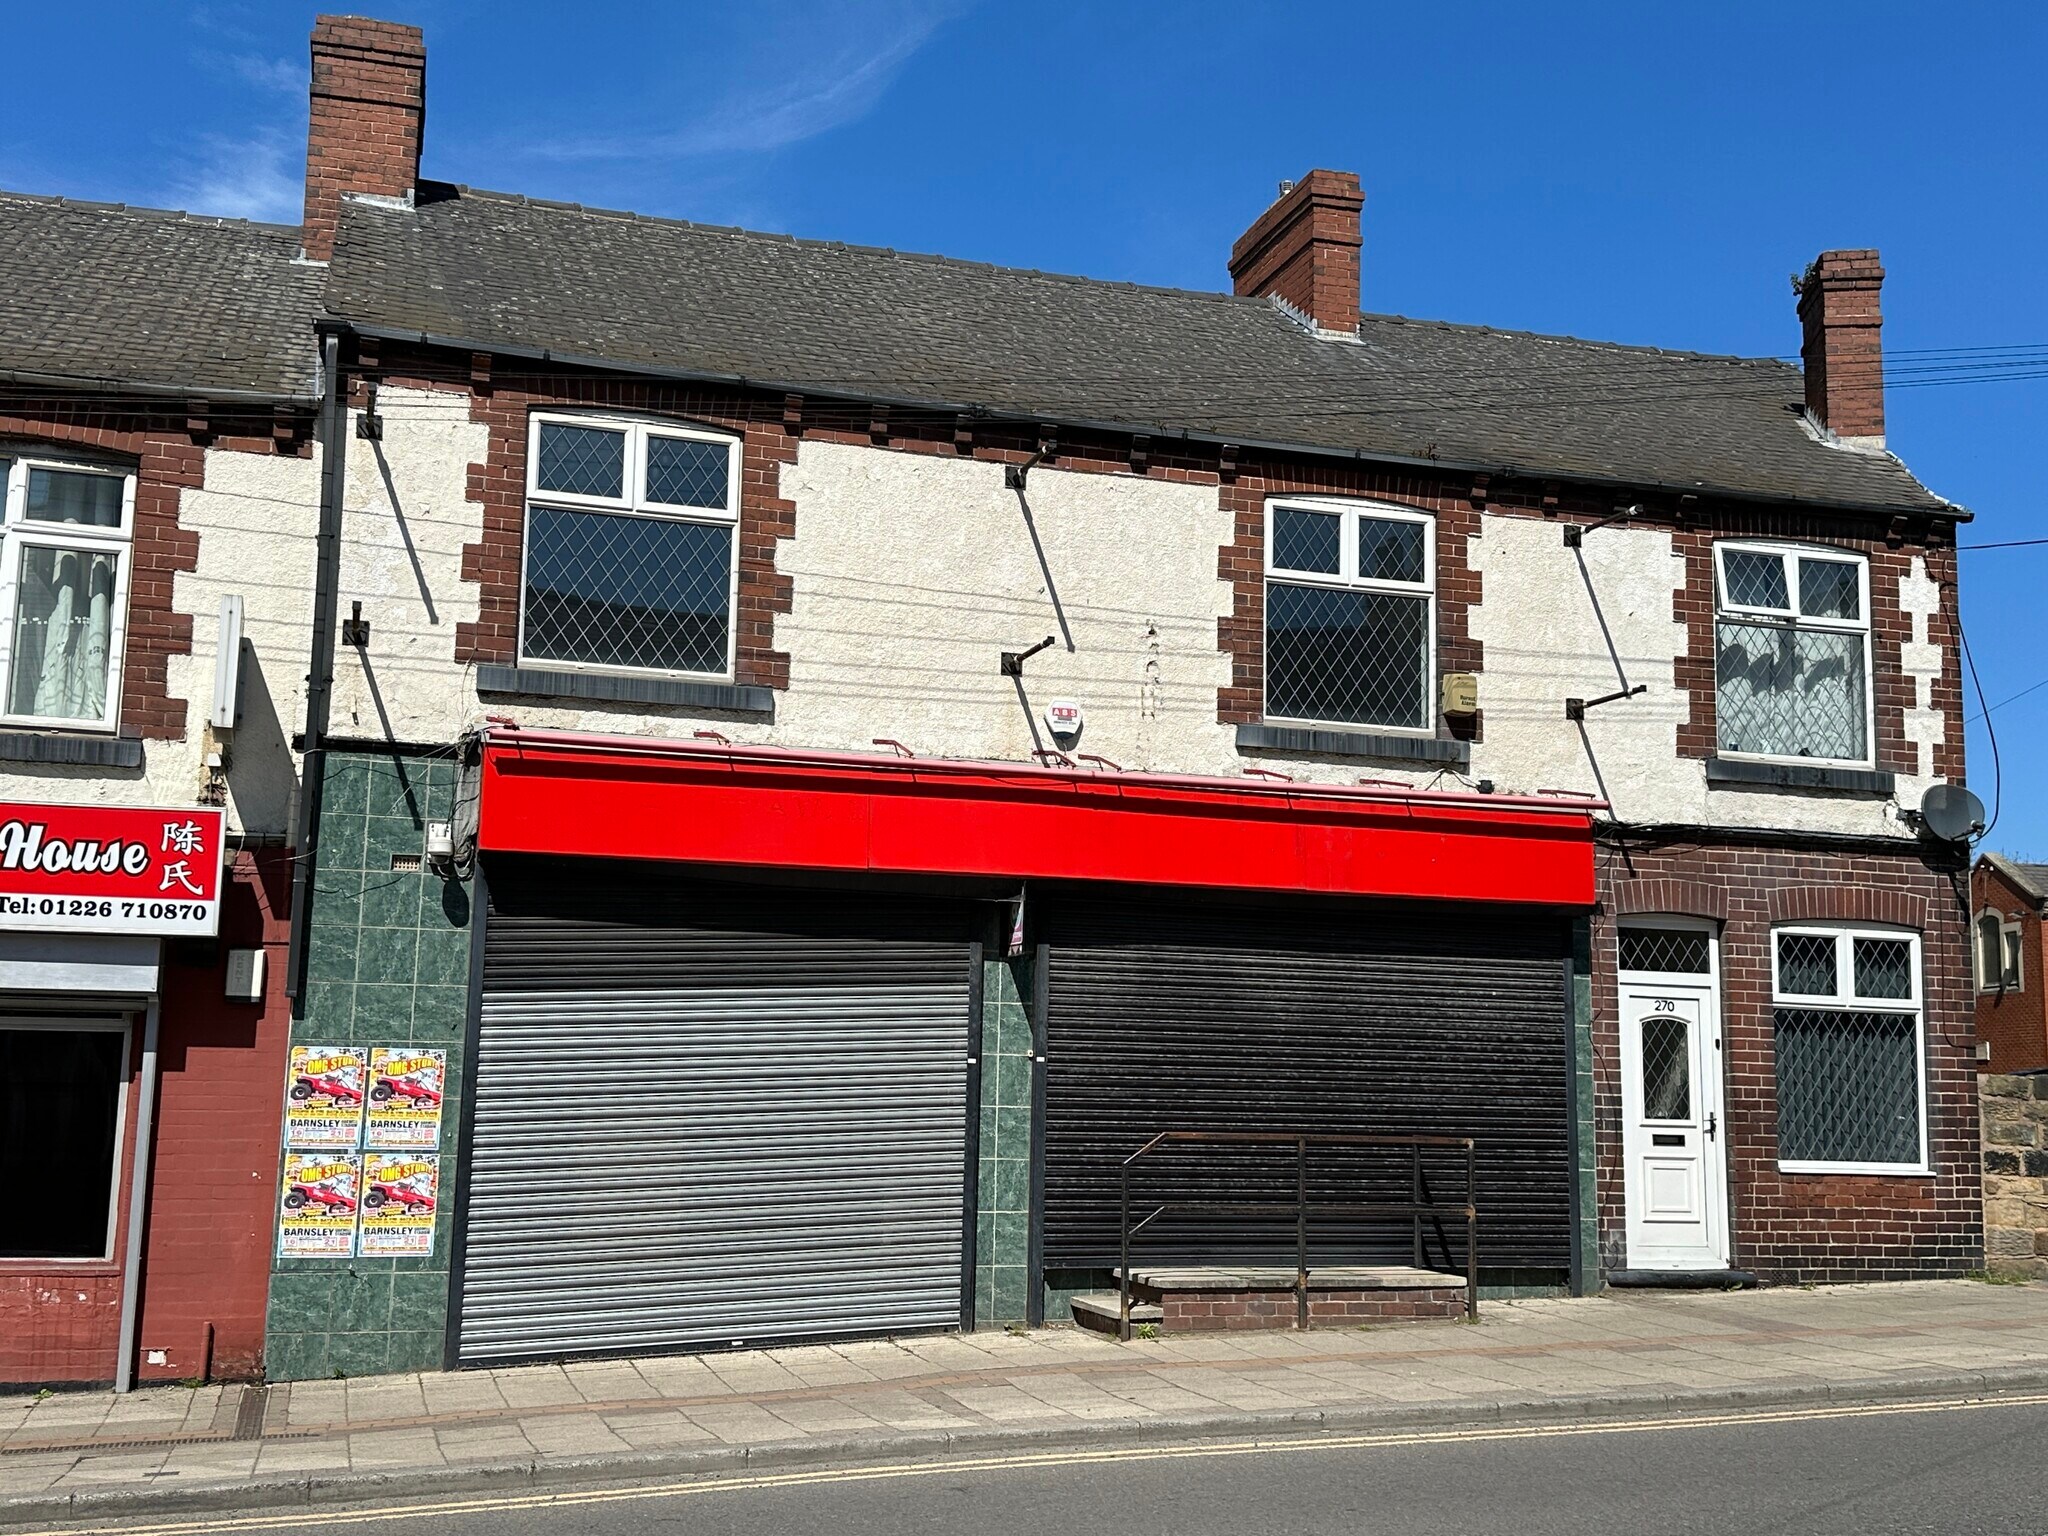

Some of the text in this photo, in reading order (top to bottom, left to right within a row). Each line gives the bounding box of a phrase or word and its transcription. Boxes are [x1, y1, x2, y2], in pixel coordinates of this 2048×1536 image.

[1053, 708, 1076, 717] ABS
[0, 821, 148, 874] House
[159, 820, 204, 895] 陈氏
[121, 902, 207, 920] 710870
[1654, 1000, 1675, 1012] 270
[306, 1059, 328, 1073] OMG
[386, 1060, 408, 1075] OMG
[290, 1118, 340, 1127] BARNSLEY
[370, 1119, 419, 1128] BARNSLEY
[300, 1167, 322, 1181] OMG
[379, 1166, 401, 1181] OMG
[283, 1227, 334, 1236] BARNSLEY
[363, 1226, 413, 1235] BARNSLEY
